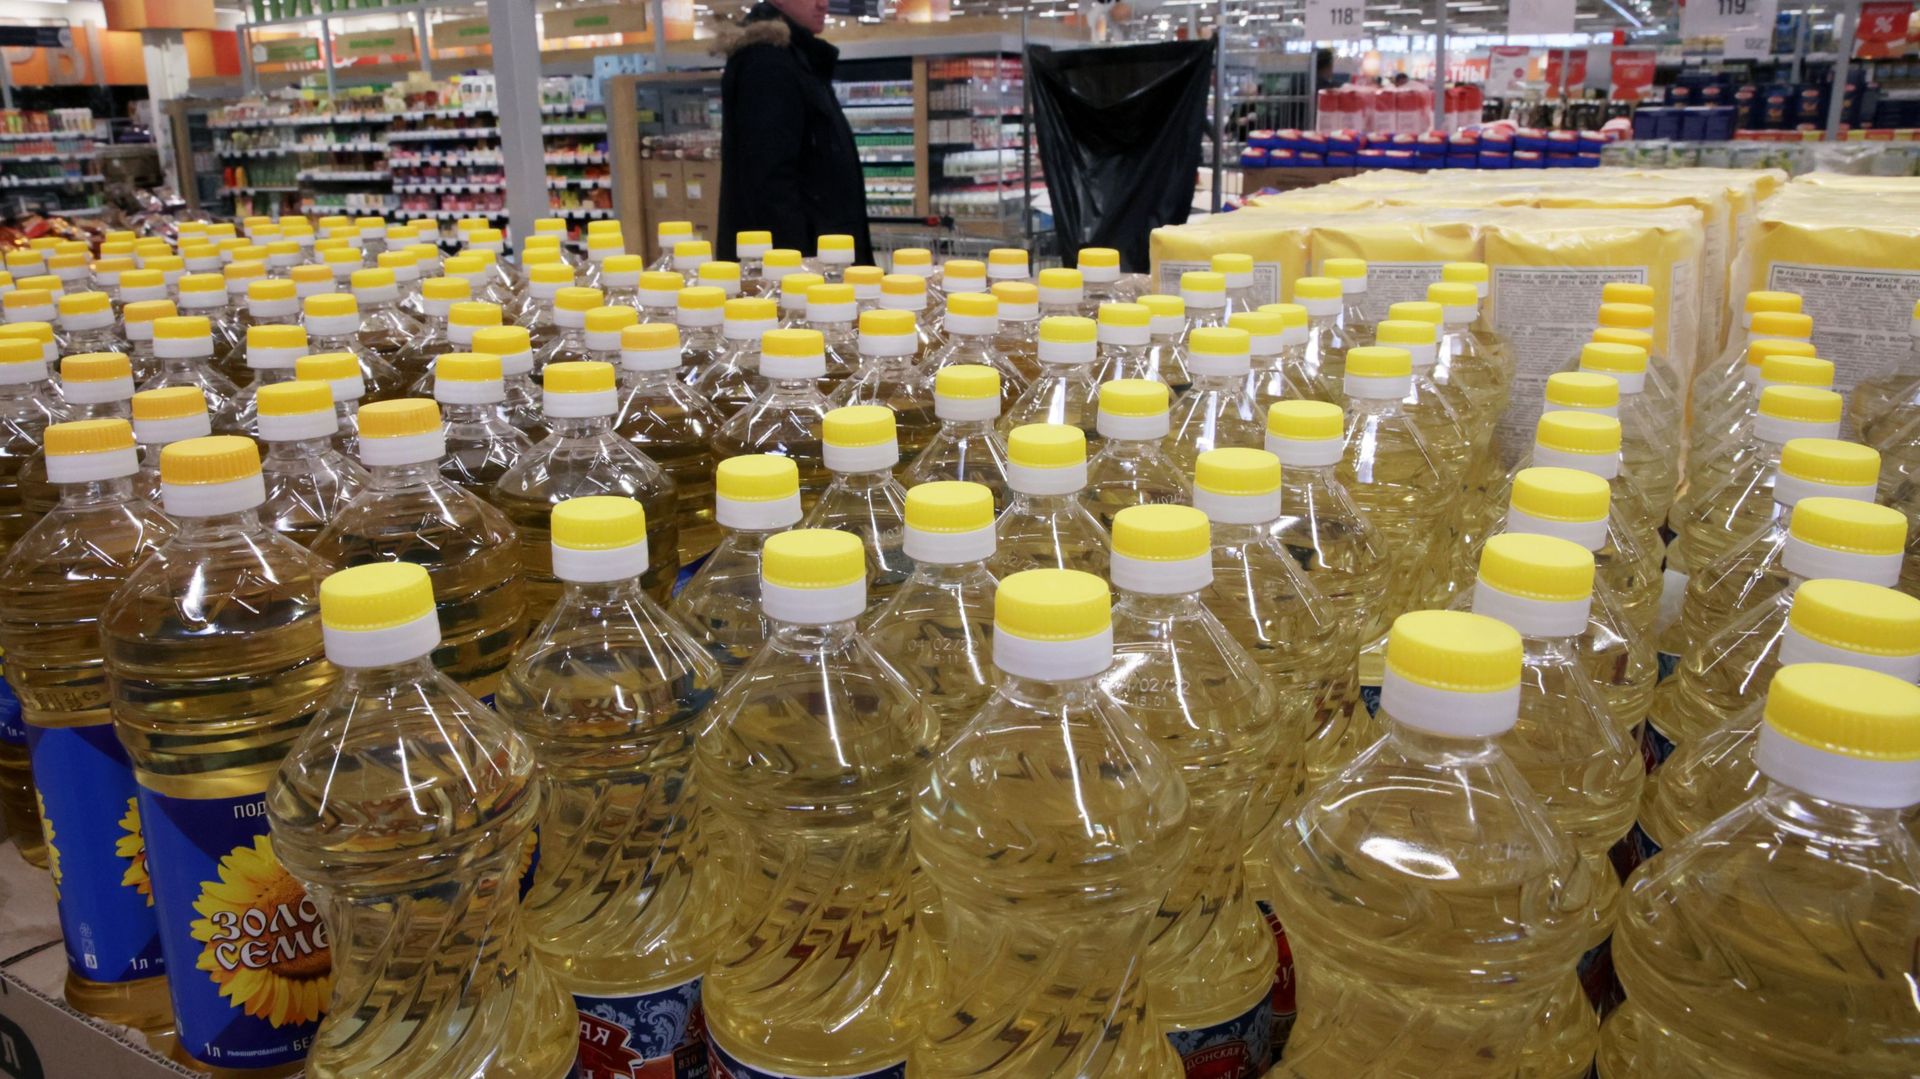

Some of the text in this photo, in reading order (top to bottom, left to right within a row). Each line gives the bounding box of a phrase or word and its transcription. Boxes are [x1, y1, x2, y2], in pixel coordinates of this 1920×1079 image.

[1719, 0, 1746, 15] 119
[1331, 7, 1353, 25] 118
[203, 1042, 221, 1058] 1л
